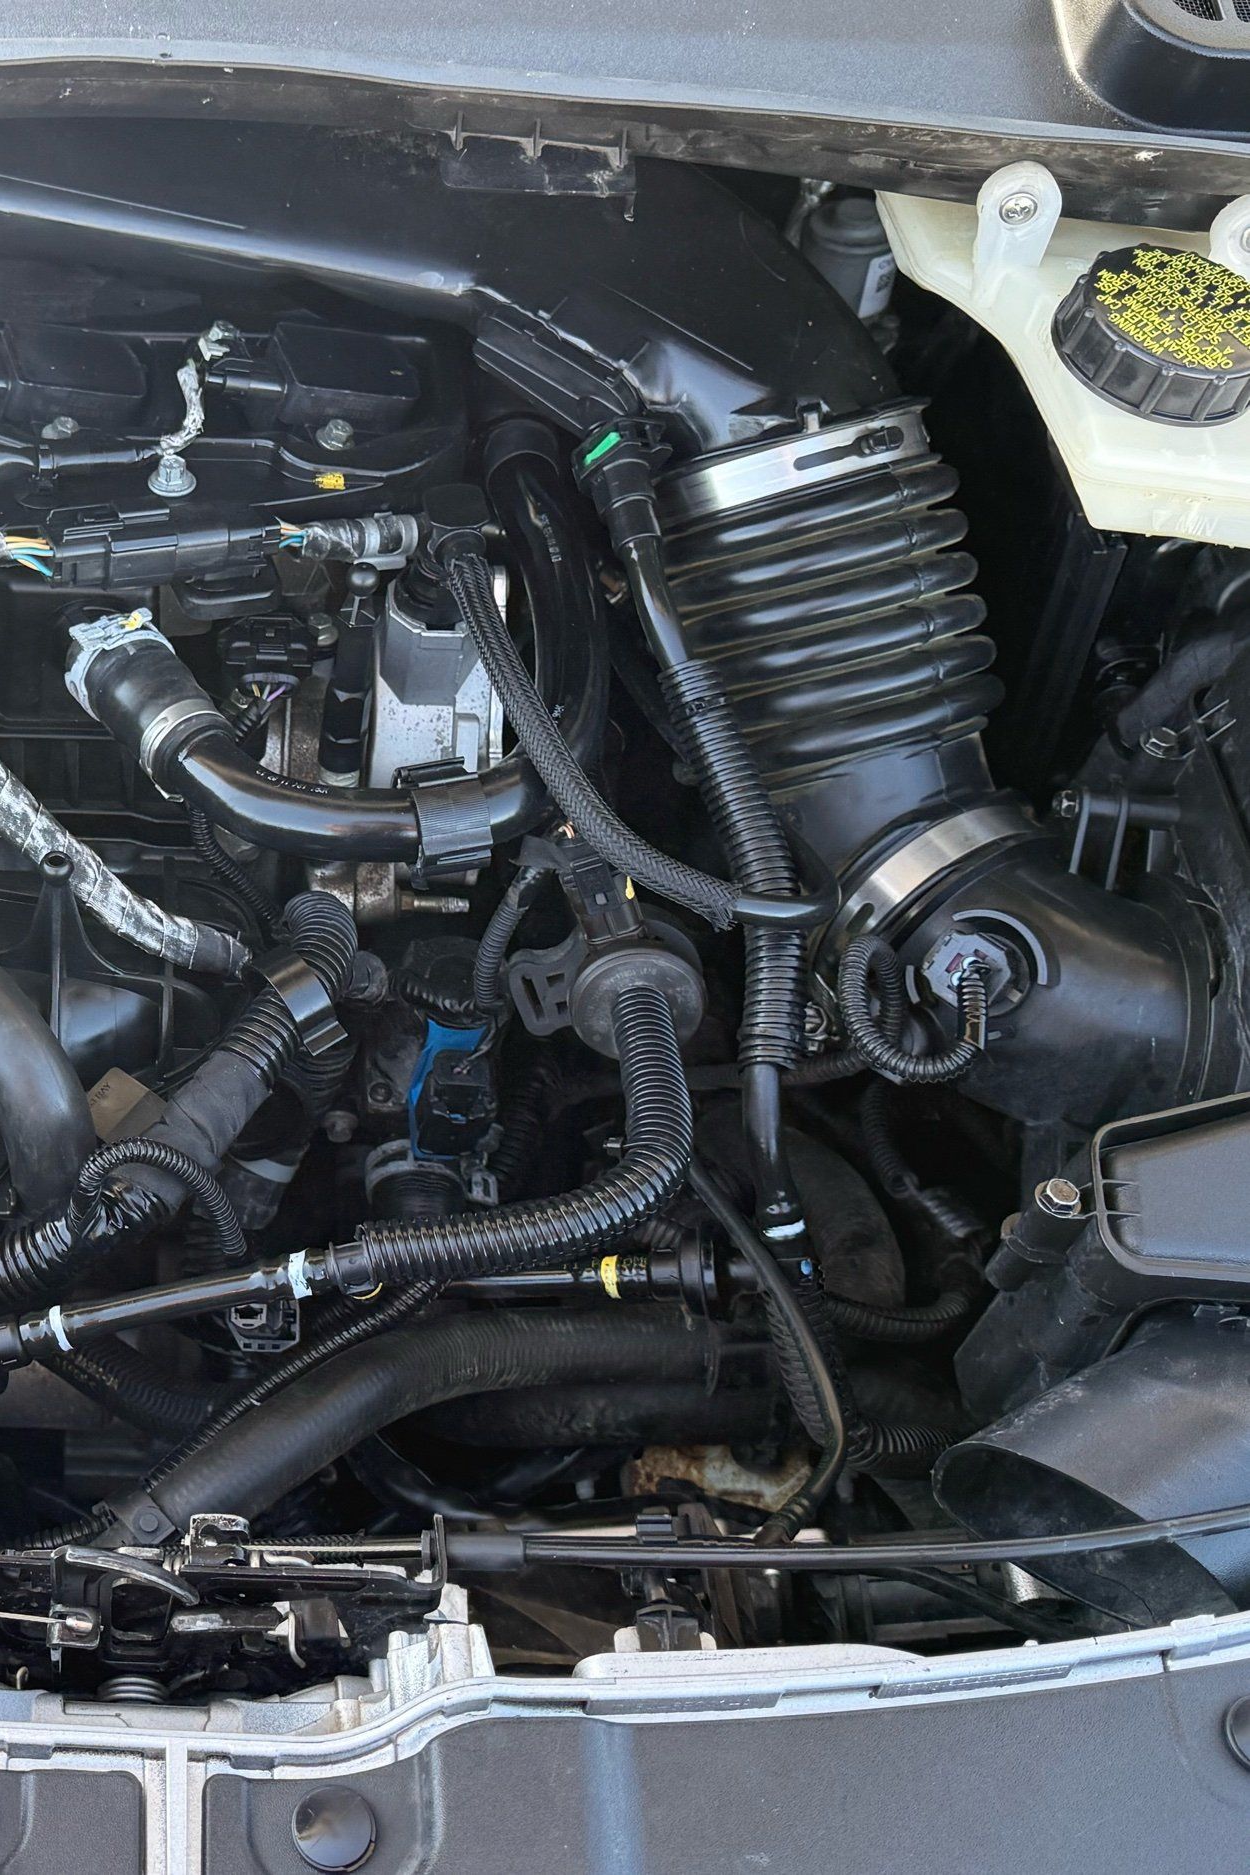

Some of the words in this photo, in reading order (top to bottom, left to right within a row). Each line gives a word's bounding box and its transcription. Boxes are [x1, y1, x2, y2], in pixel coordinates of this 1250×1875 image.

[1154, 250, 1190, 274] LIQUIDE
[1097, 269, 1131, 290] FROM
[1132, 258, 1183, 290] BOUCHON
[1191, 274, 1209, 286] DU
[1094, 280, 1118, 295] USE
[1182, 290, 1203, 305] LE
[1210, 288, 1234, 305] QUE
[1096, 294, 1121, 308] CAP
[1132, 291, 1164, 312] FLUID
[1208, 297, 1224, 310] LE
[1123, 308, 1160, 337] FILLER
[1225, 310, 1241, 322] DE
[1107, 311, 1164, 355] WARNING:
[1177, 322, 1203, 342] DOT
[1180, 312, 1221, 344] SEALED
[1160, 337, 1198, 367] CLEAN
[1175, 335, 1217, 369] BEFORE
[1202, 345, 1233, 369] ONLY
[1223, 346, 1234, 354] A
